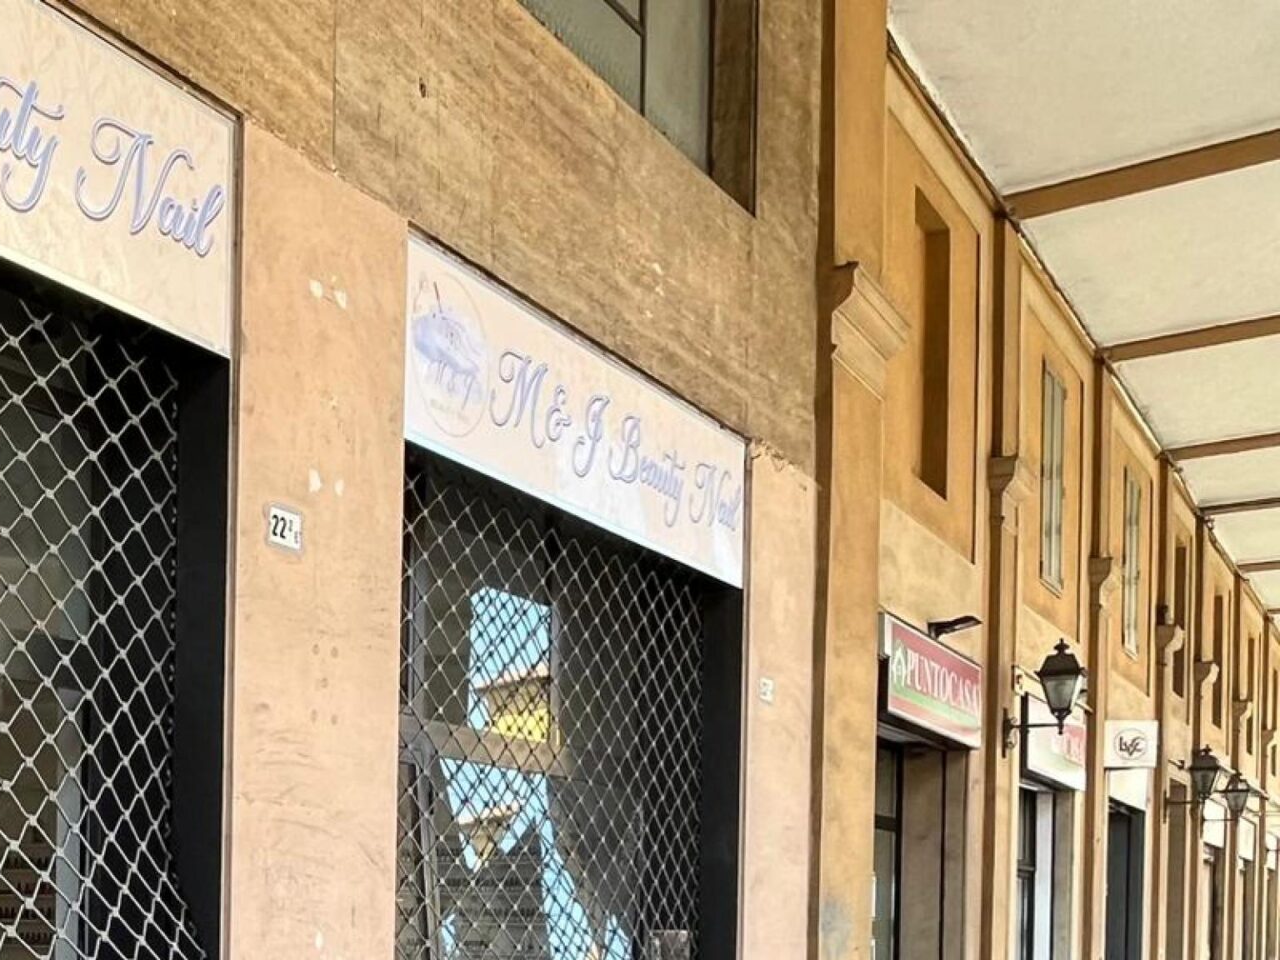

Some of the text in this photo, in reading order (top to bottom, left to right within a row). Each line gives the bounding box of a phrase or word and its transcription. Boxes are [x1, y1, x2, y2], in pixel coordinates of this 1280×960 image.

[75, 117, 225, 257] Nail
[608, 415, 685, 528] Beauty
[689, 462, 742, 533] Nail
